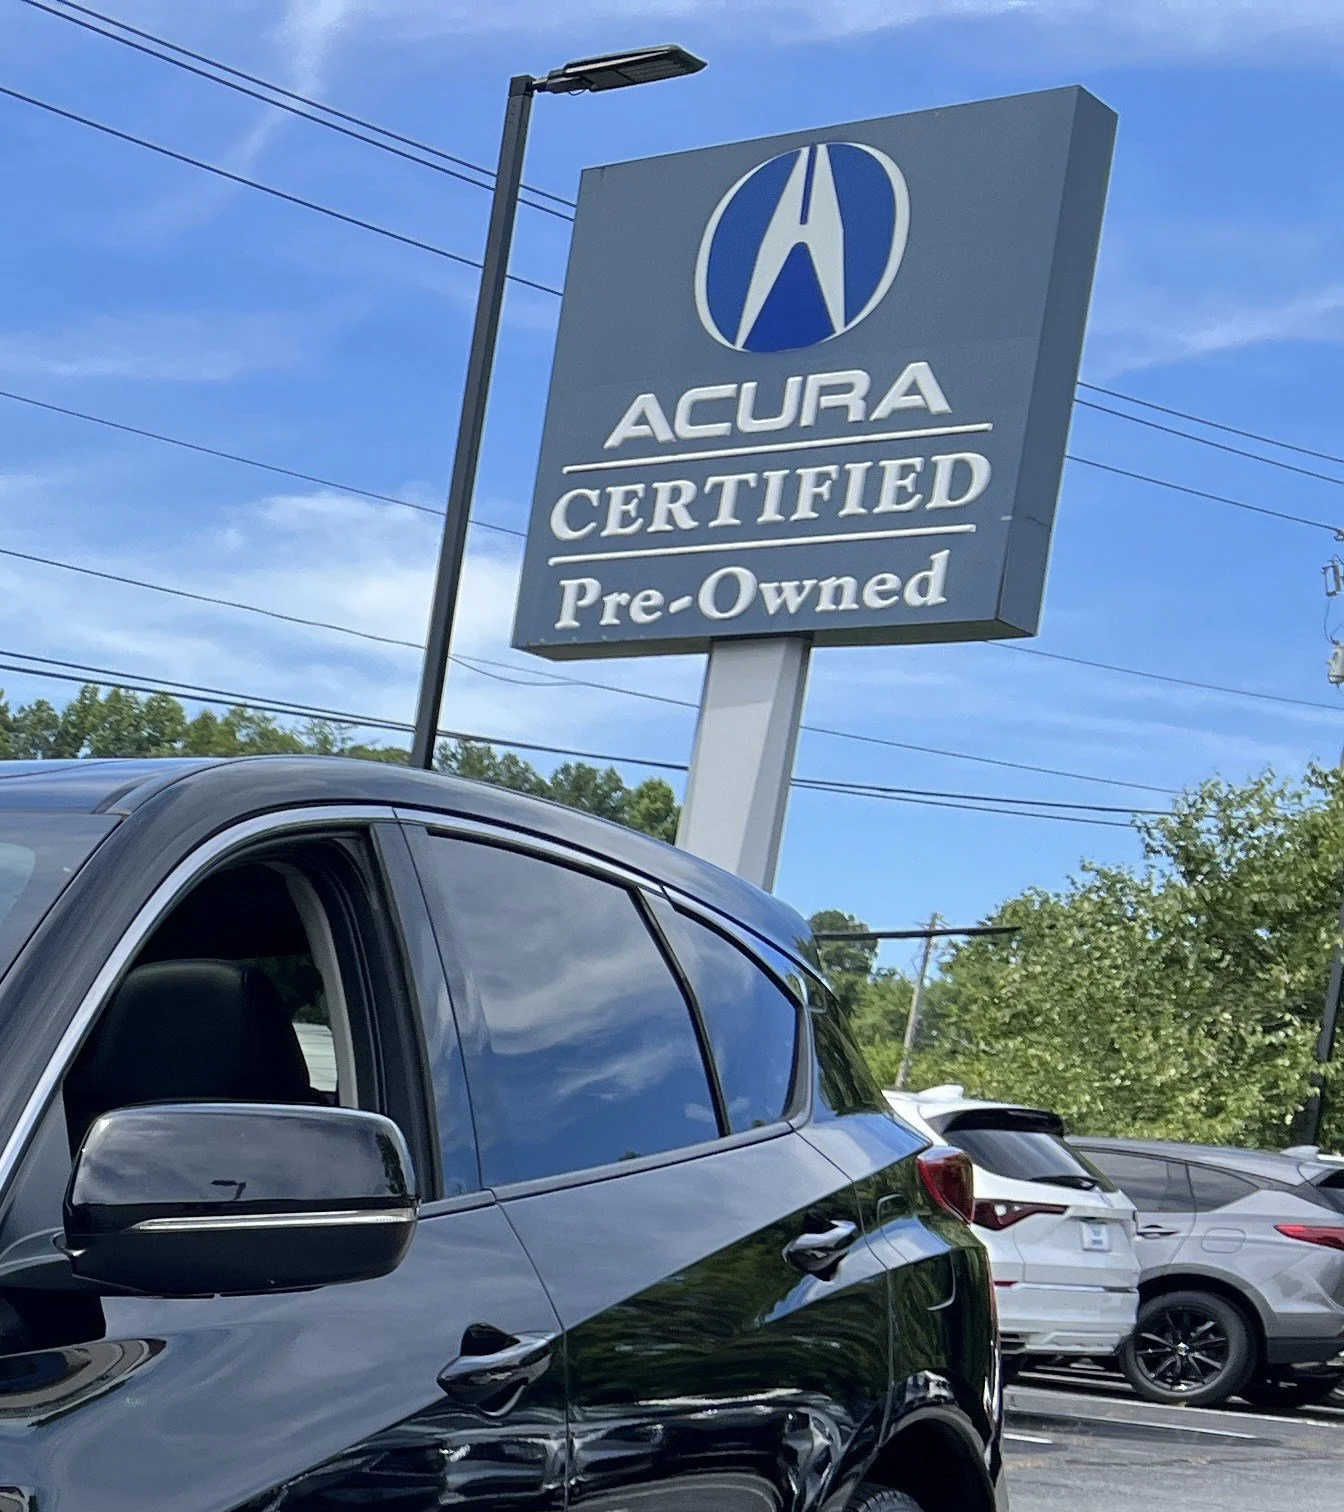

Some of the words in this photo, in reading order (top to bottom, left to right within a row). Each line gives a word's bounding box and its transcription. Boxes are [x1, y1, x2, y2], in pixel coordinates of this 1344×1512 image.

[603, 361, 953, 449] ACURA
[548, 451, 992, 542] CERTIFIED
[554, 550, 951, 630] Pre-Owned
